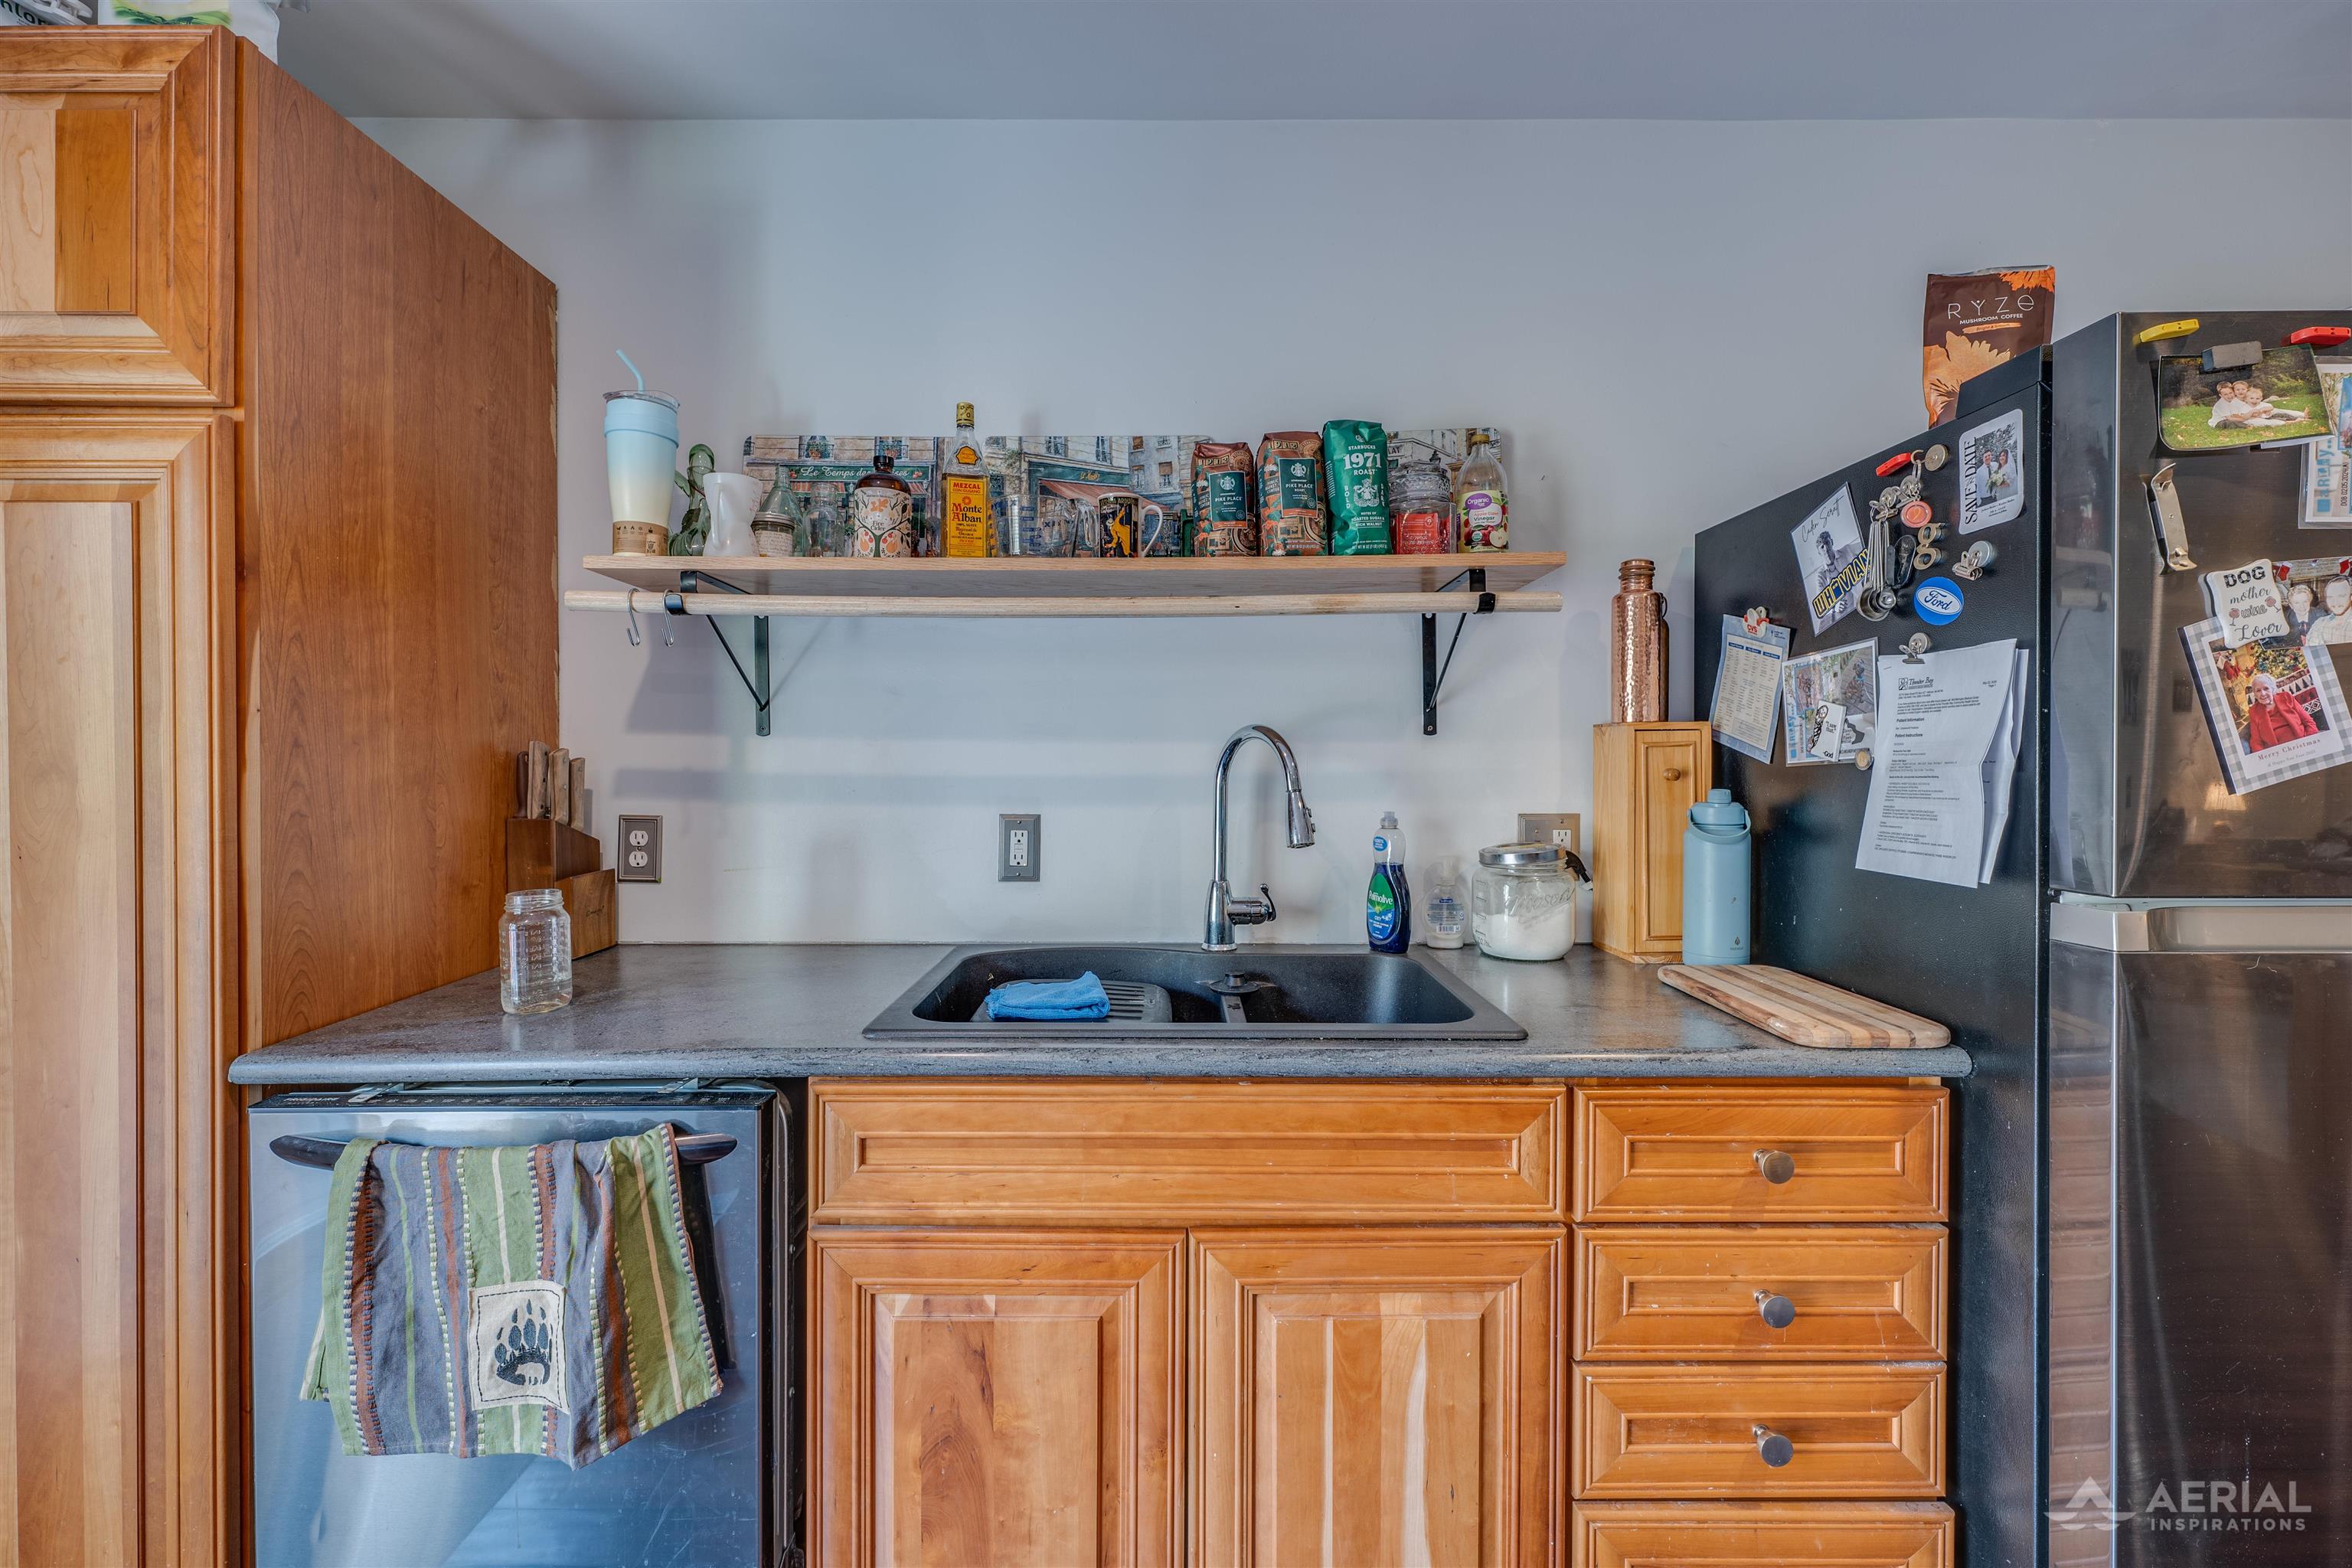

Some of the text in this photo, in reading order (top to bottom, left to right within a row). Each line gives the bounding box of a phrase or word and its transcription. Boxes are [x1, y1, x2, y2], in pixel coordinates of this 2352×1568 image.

[1959, 315, 1998, 325] MUSHROOM
[1343, 452, 1382, 470] 1971
[1964, 436, 1978, 477] DATE
[800, 466, 819, 476] Le
[822, 466, 855, 479] Temps
[952, 502, 982, 513] Monte
[1467, 497, 1490, 505] Organic
[1965, 484, 1978, 525] SAVE
[952, 512, 982, 523] Alban
[2223, 566, 2266, 588] DOG
[1924, 590, 1953, 611] Ford
[2230, 586, 2272, 605] mother
[2240, 604, 2268, 619] wine
[1747, 624, 1758, 633] CVS
[2234, 622, 2282, 642] Lover
[1925, 676, 1934, 687] Bay
[2257, 739, 2321, 761] Merry Christmas
[1368, 890, 1393, 905] Palmolive
